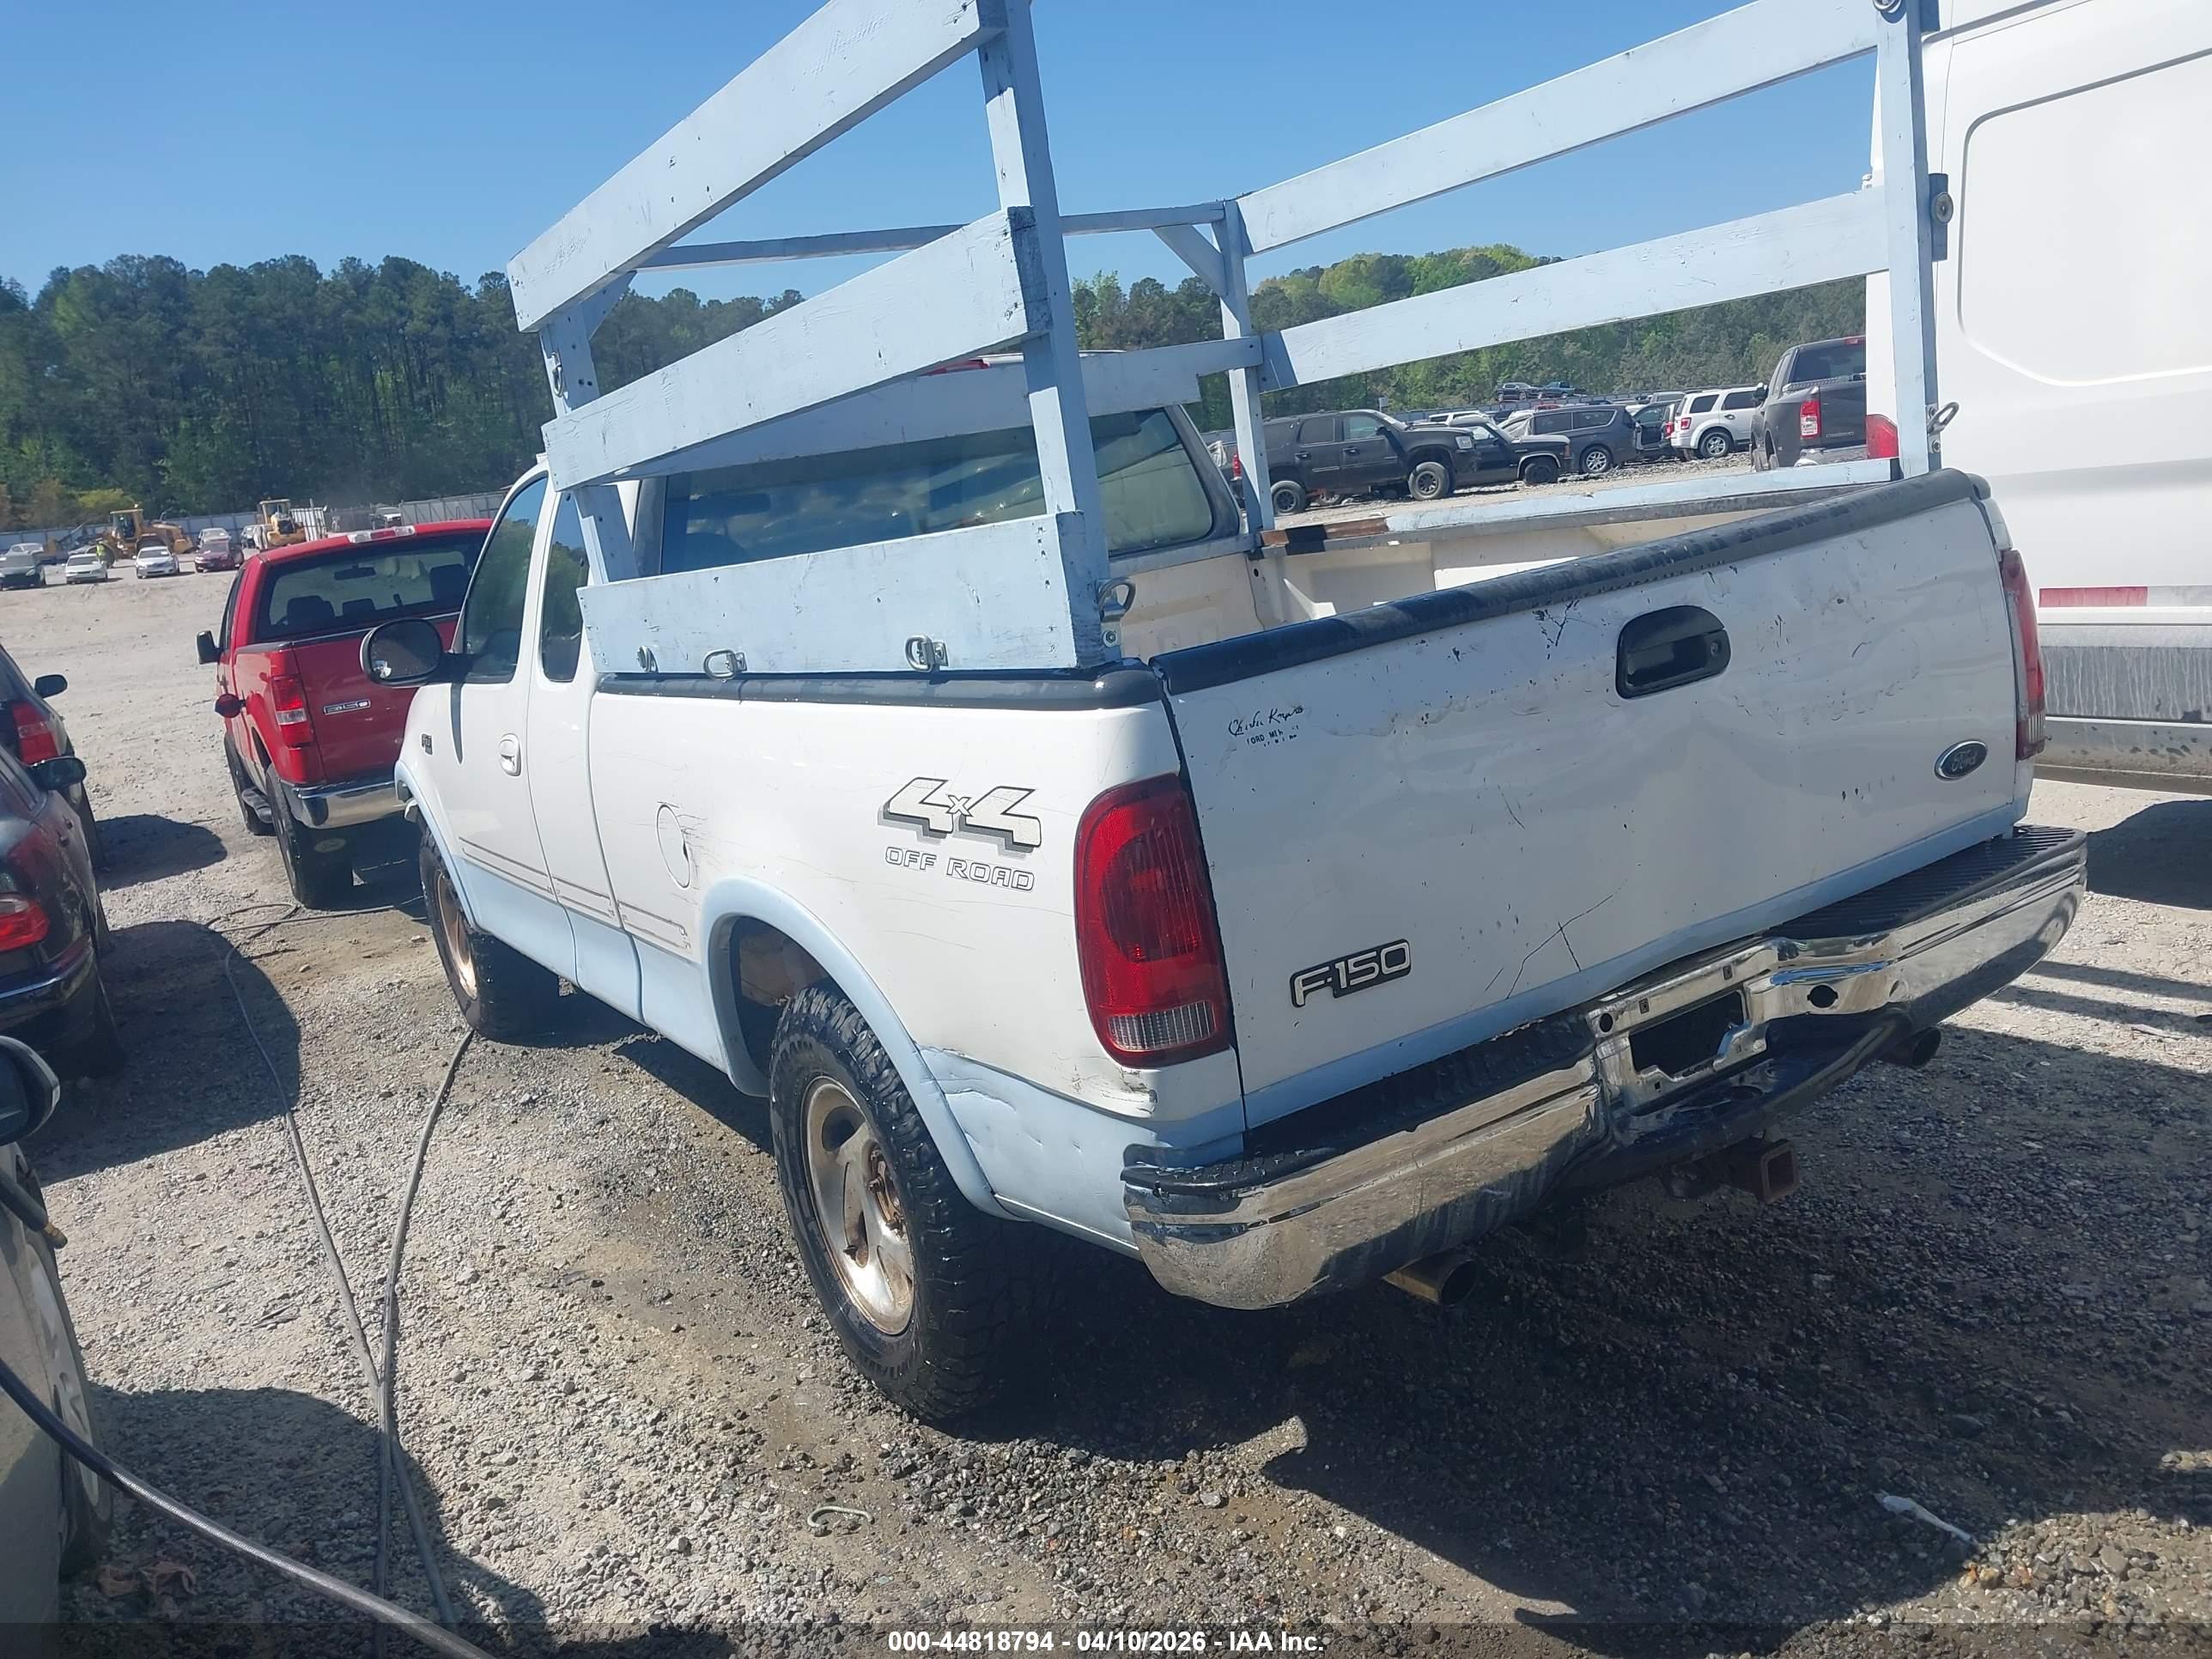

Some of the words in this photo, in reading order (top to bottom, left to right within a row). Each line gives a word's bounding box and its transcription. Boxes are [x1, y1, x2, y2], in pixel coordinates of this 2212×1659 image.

[885, 846, 937, 870] OFF
[946, 857, 1036, 891] ROAD
[1291, 939, 1412, 1007] F-150
